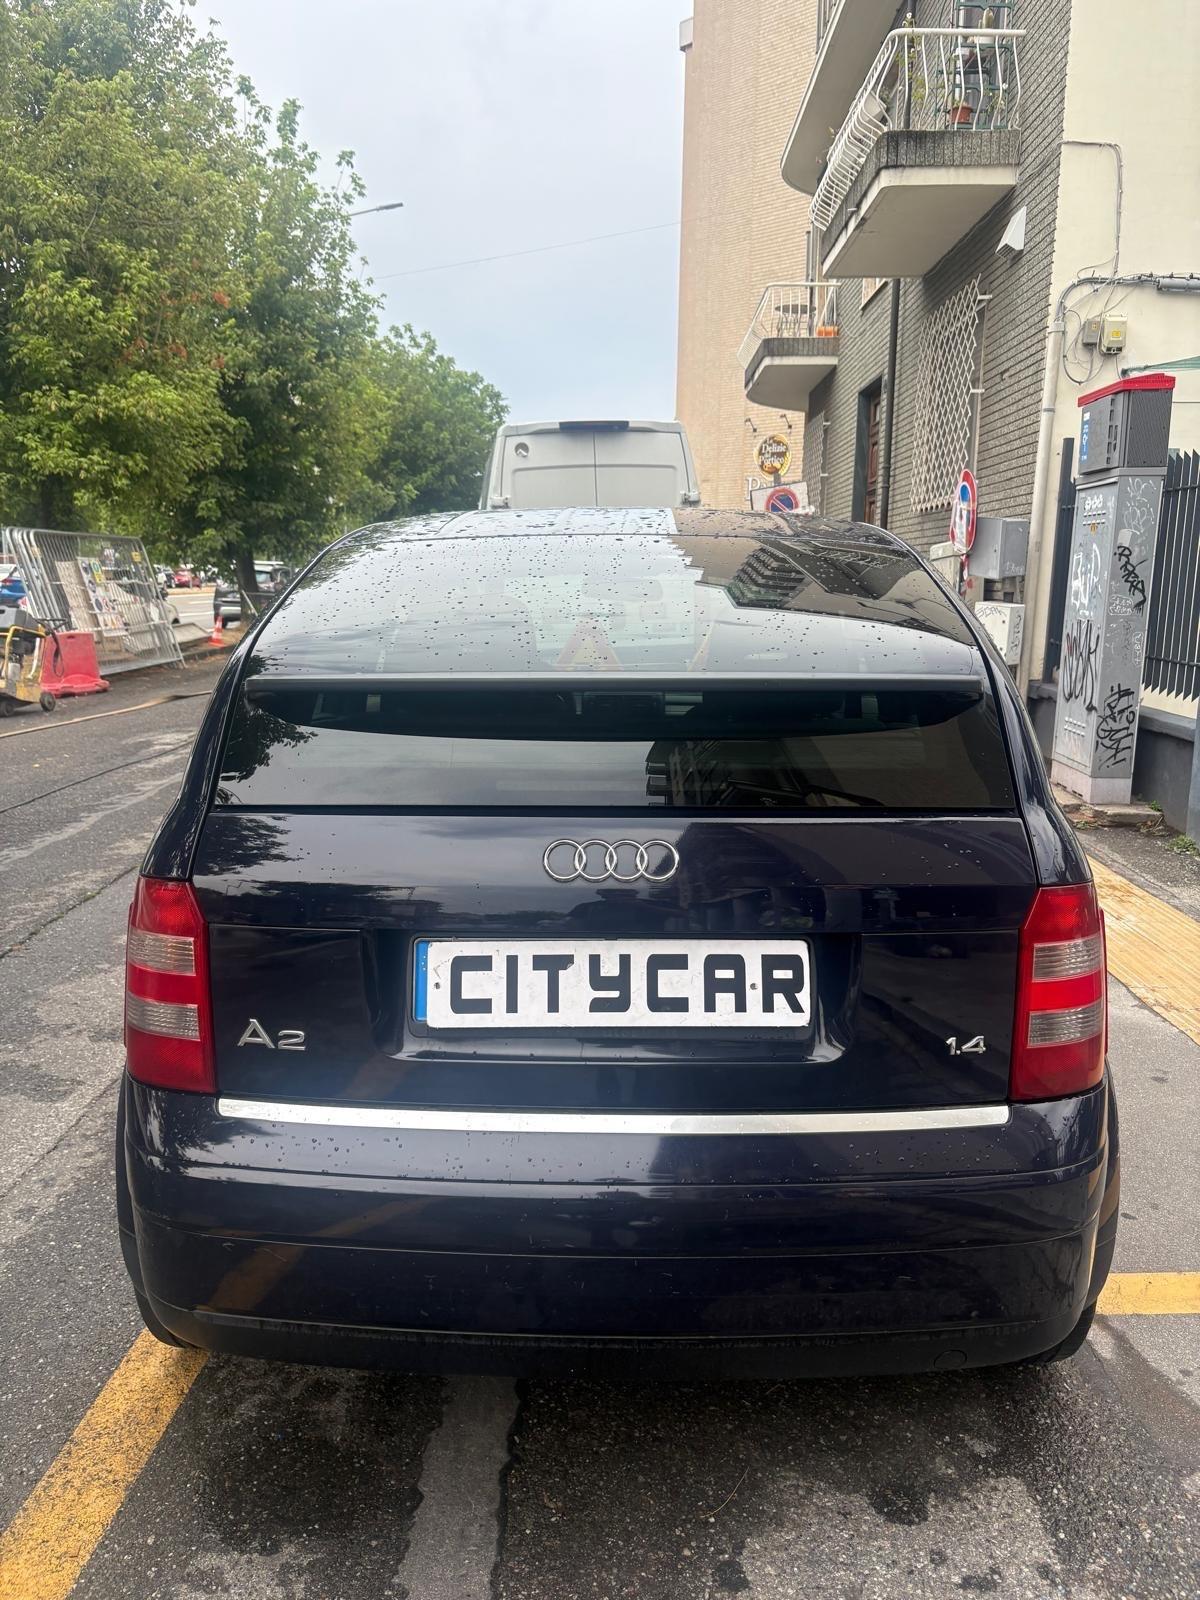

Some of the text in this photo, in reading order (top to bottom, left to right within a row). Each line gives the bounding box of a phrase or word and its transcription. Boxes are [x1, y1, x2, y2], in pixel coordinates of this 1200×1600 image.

[762, 444, 786, 453] Delizie
[759, 455, 785, 464] Portico
[450, 953, 805, 1015] CITYCAR
[237, 1018, 306, 1051] A2
[945, 1035, 987, 1056] 1.4
